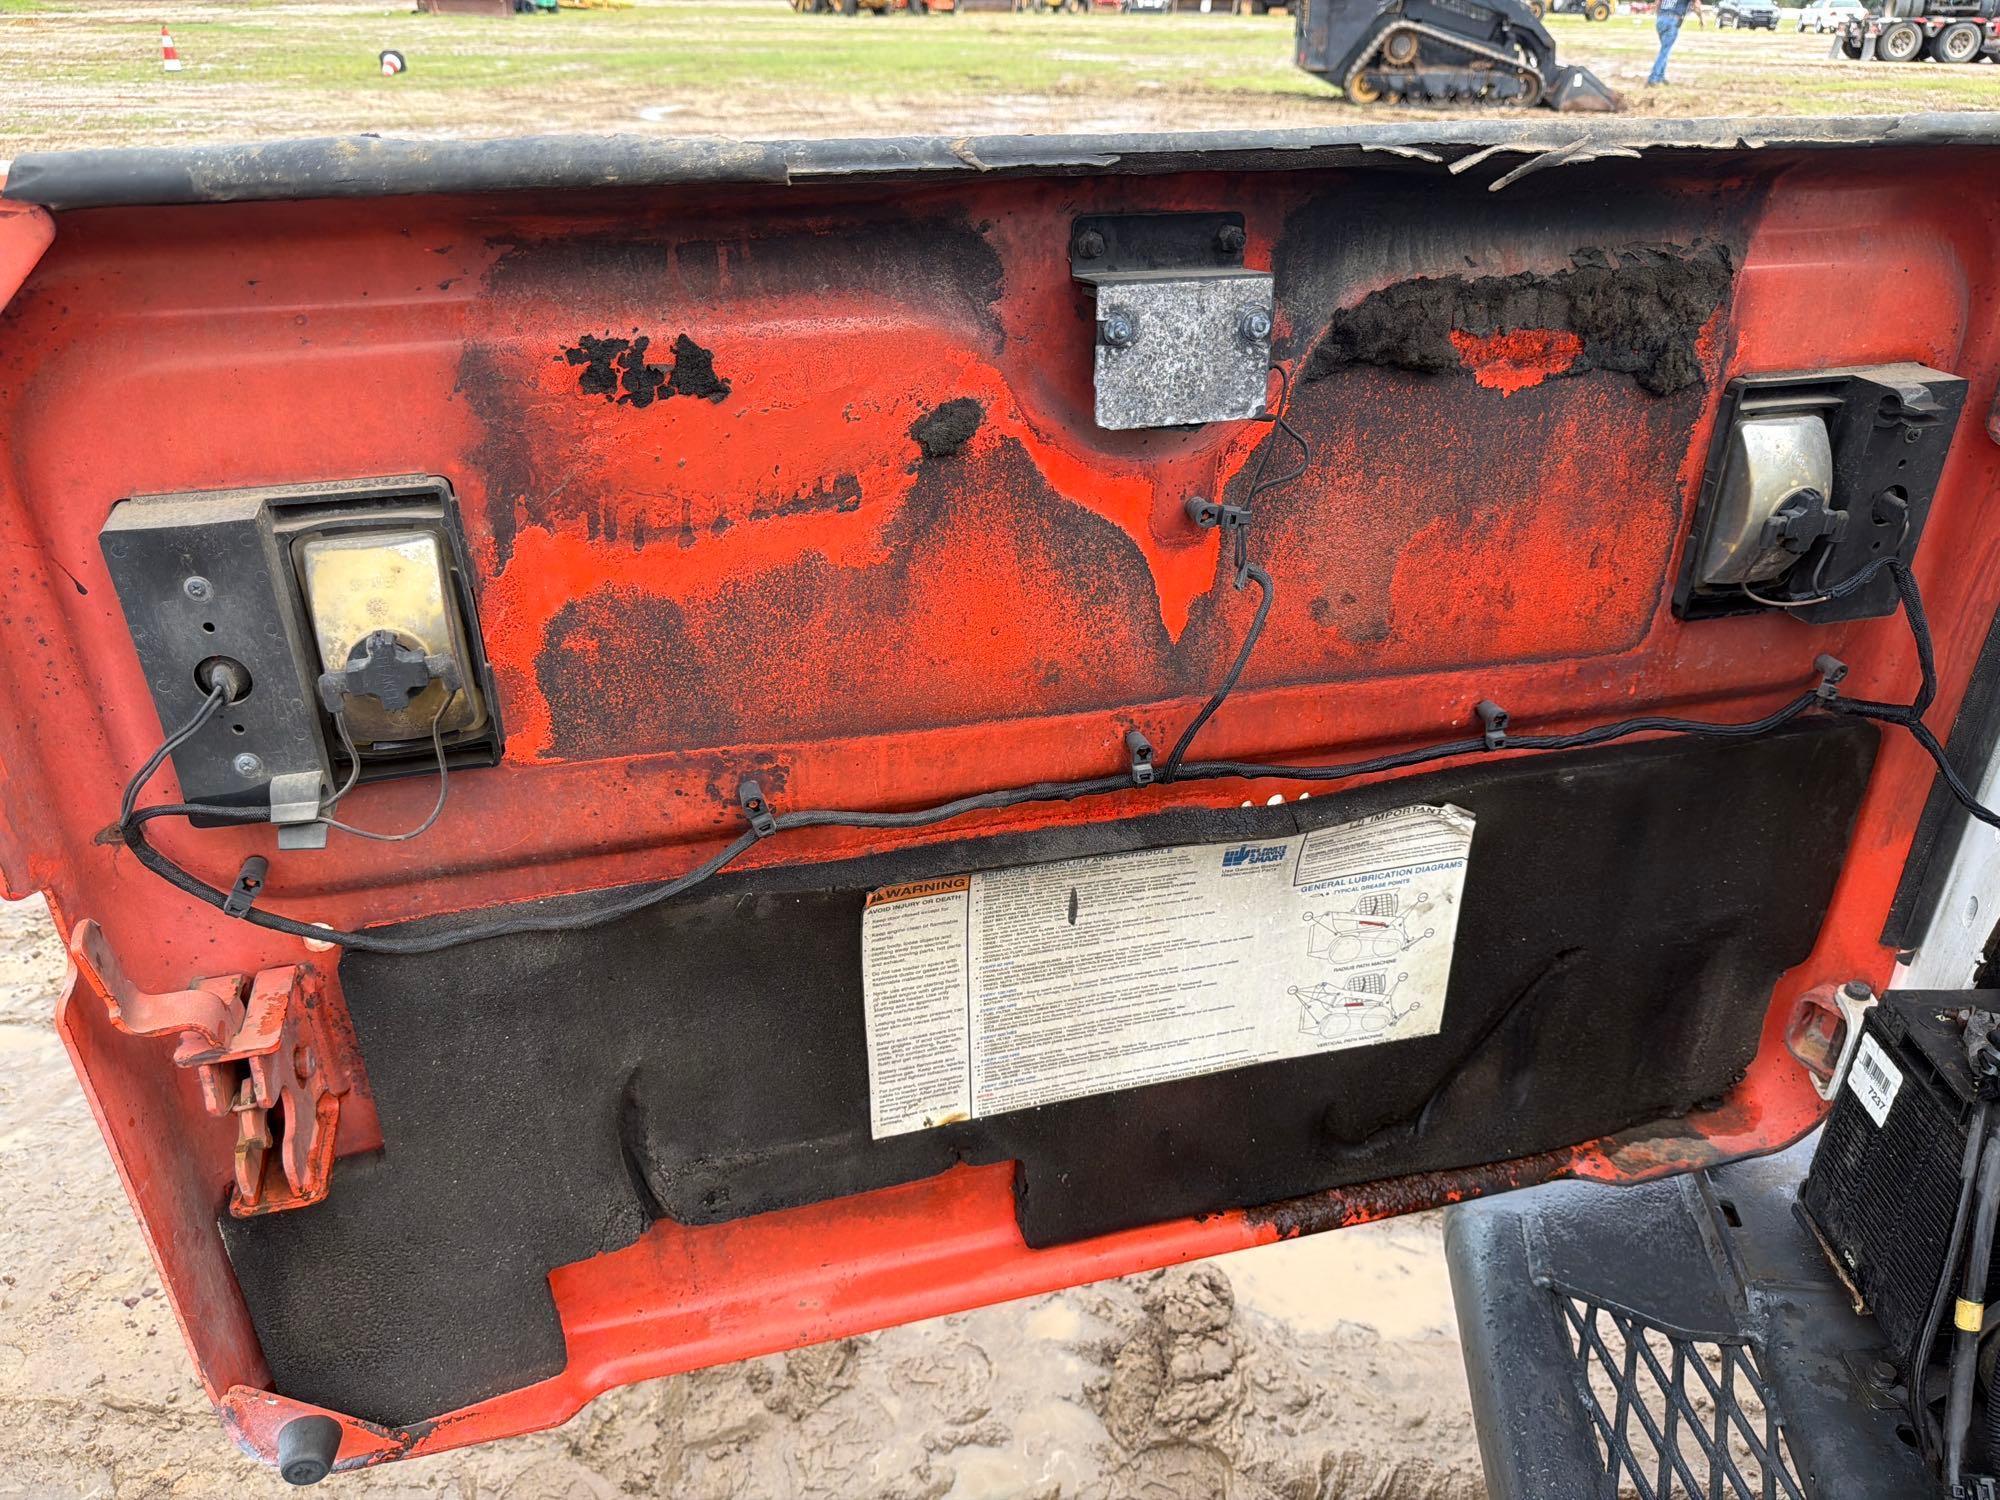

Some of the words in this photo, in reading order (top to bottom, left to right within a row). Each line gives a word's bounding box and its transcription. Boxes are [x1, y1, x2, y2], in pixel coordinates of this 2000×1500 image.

[1370, 806, 1442, 822] IMPORTANT
[1248, 854, 1285, 864] SMART
[1301, 880, 1345, 893] GENERAL
[1349, 869, 1412, 885] LUBRICATION
[1415, 860, 1462, 874] DIAGRAMS
[886, 878, 965, 898] WARNING
[868, 906, 890, 915] AVOID
[893, 901, 920, 910] INJURY
[936, 894, 961, 903] DEATH
[993, 1102, 1031, 1113] OPERATION
[1039, 1091, 1086, 1104] MAINTENANCE
[1088, 1085, 1115, 1094] MANUAL
[1153, 1070, 1196, 1082] INFORMATION
[1213, 1058, 1259, 1070] INSTRUCTIONS
[1868, 1084, 1885, 1109] 7237
